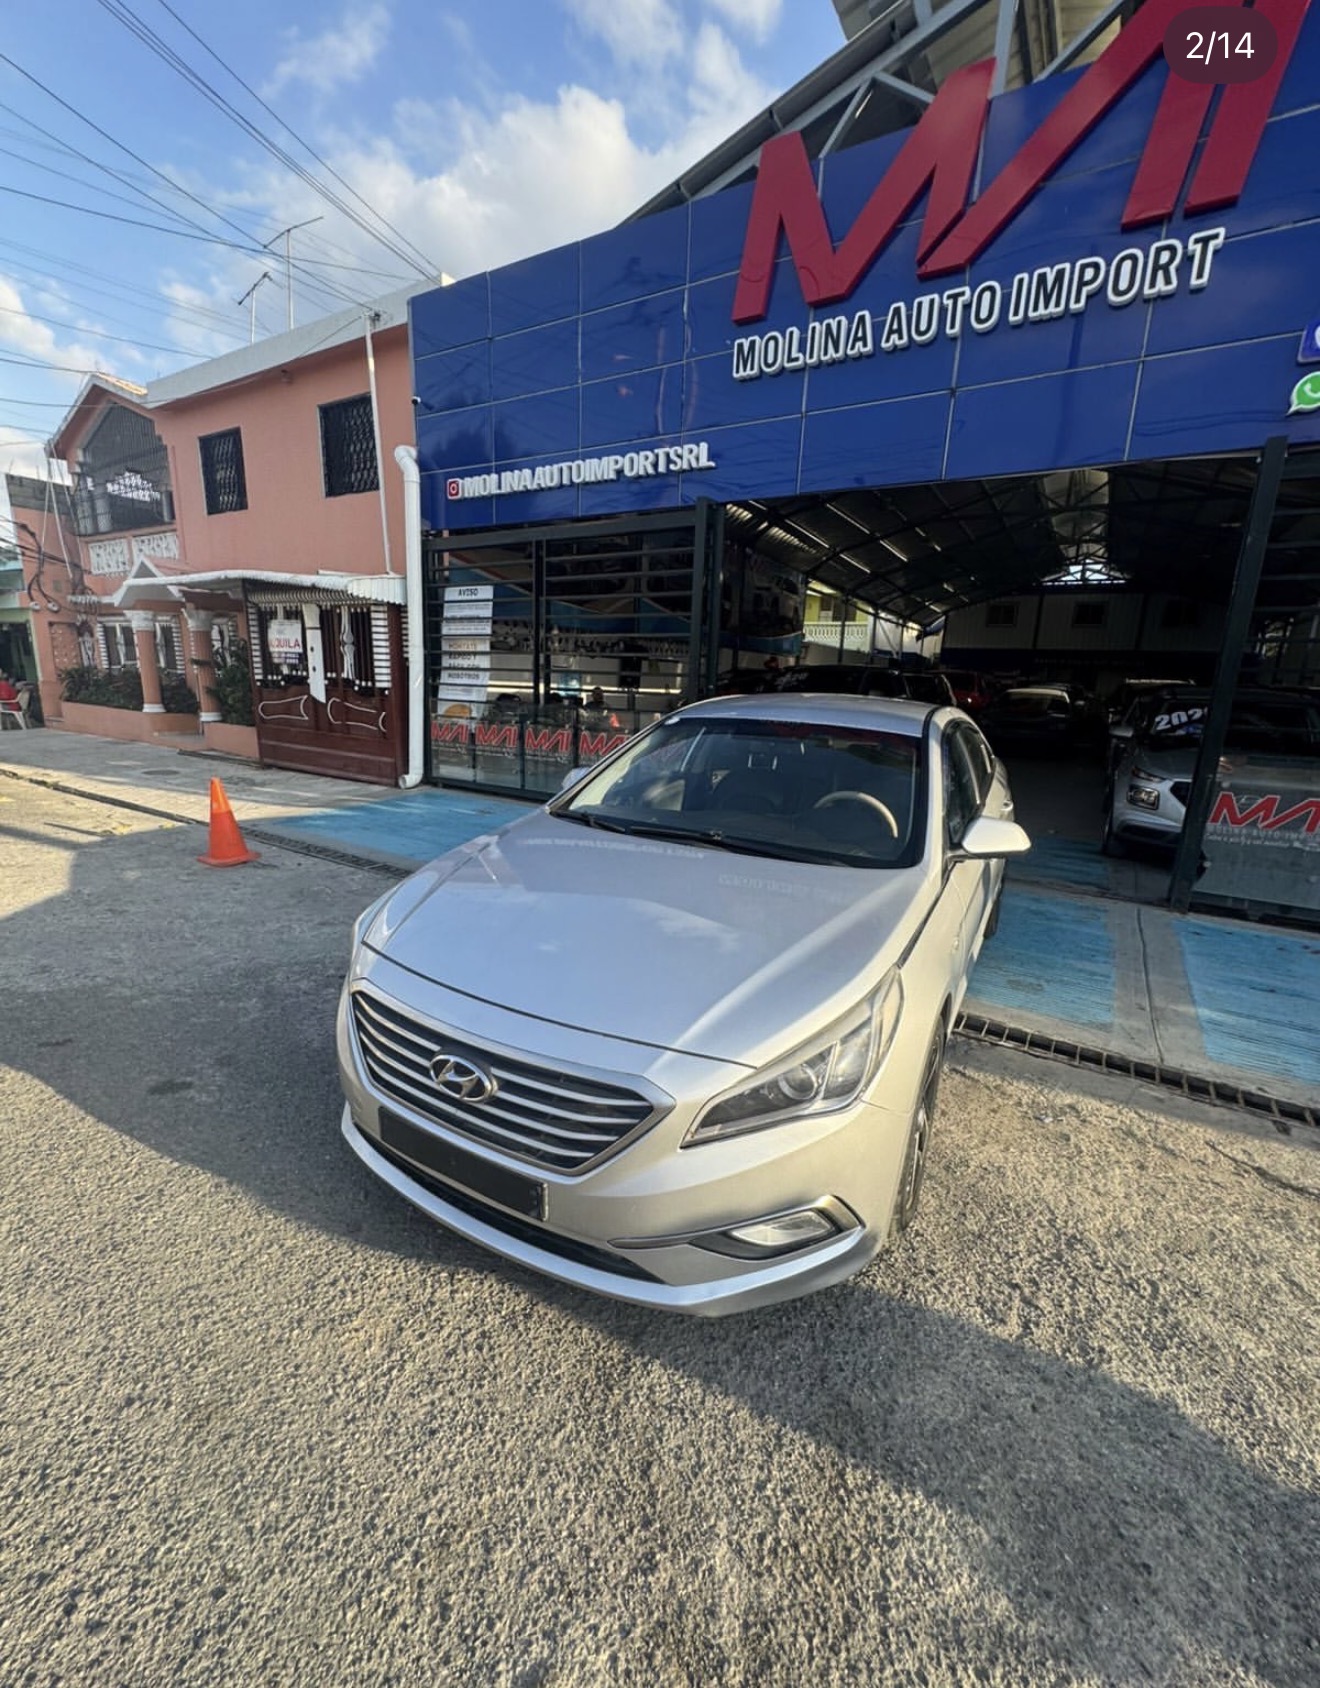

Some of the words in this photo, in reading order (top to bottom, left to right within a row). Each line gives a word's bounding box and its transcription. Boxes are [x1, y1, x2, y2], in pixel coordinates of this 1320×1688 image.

[732, 310, 872, 380] MOLINA
[882, 281, 1000, 348] AUTO
[1008, 227, 1226, 325] IMPORT
[464, 442, 715, 497] MOLINAAUTOIMPORTSRL
[458, 588, 479, 597] AVISO
[1155, 706, 1208, 731] 202
[525, 727, 573, 753] MAI
